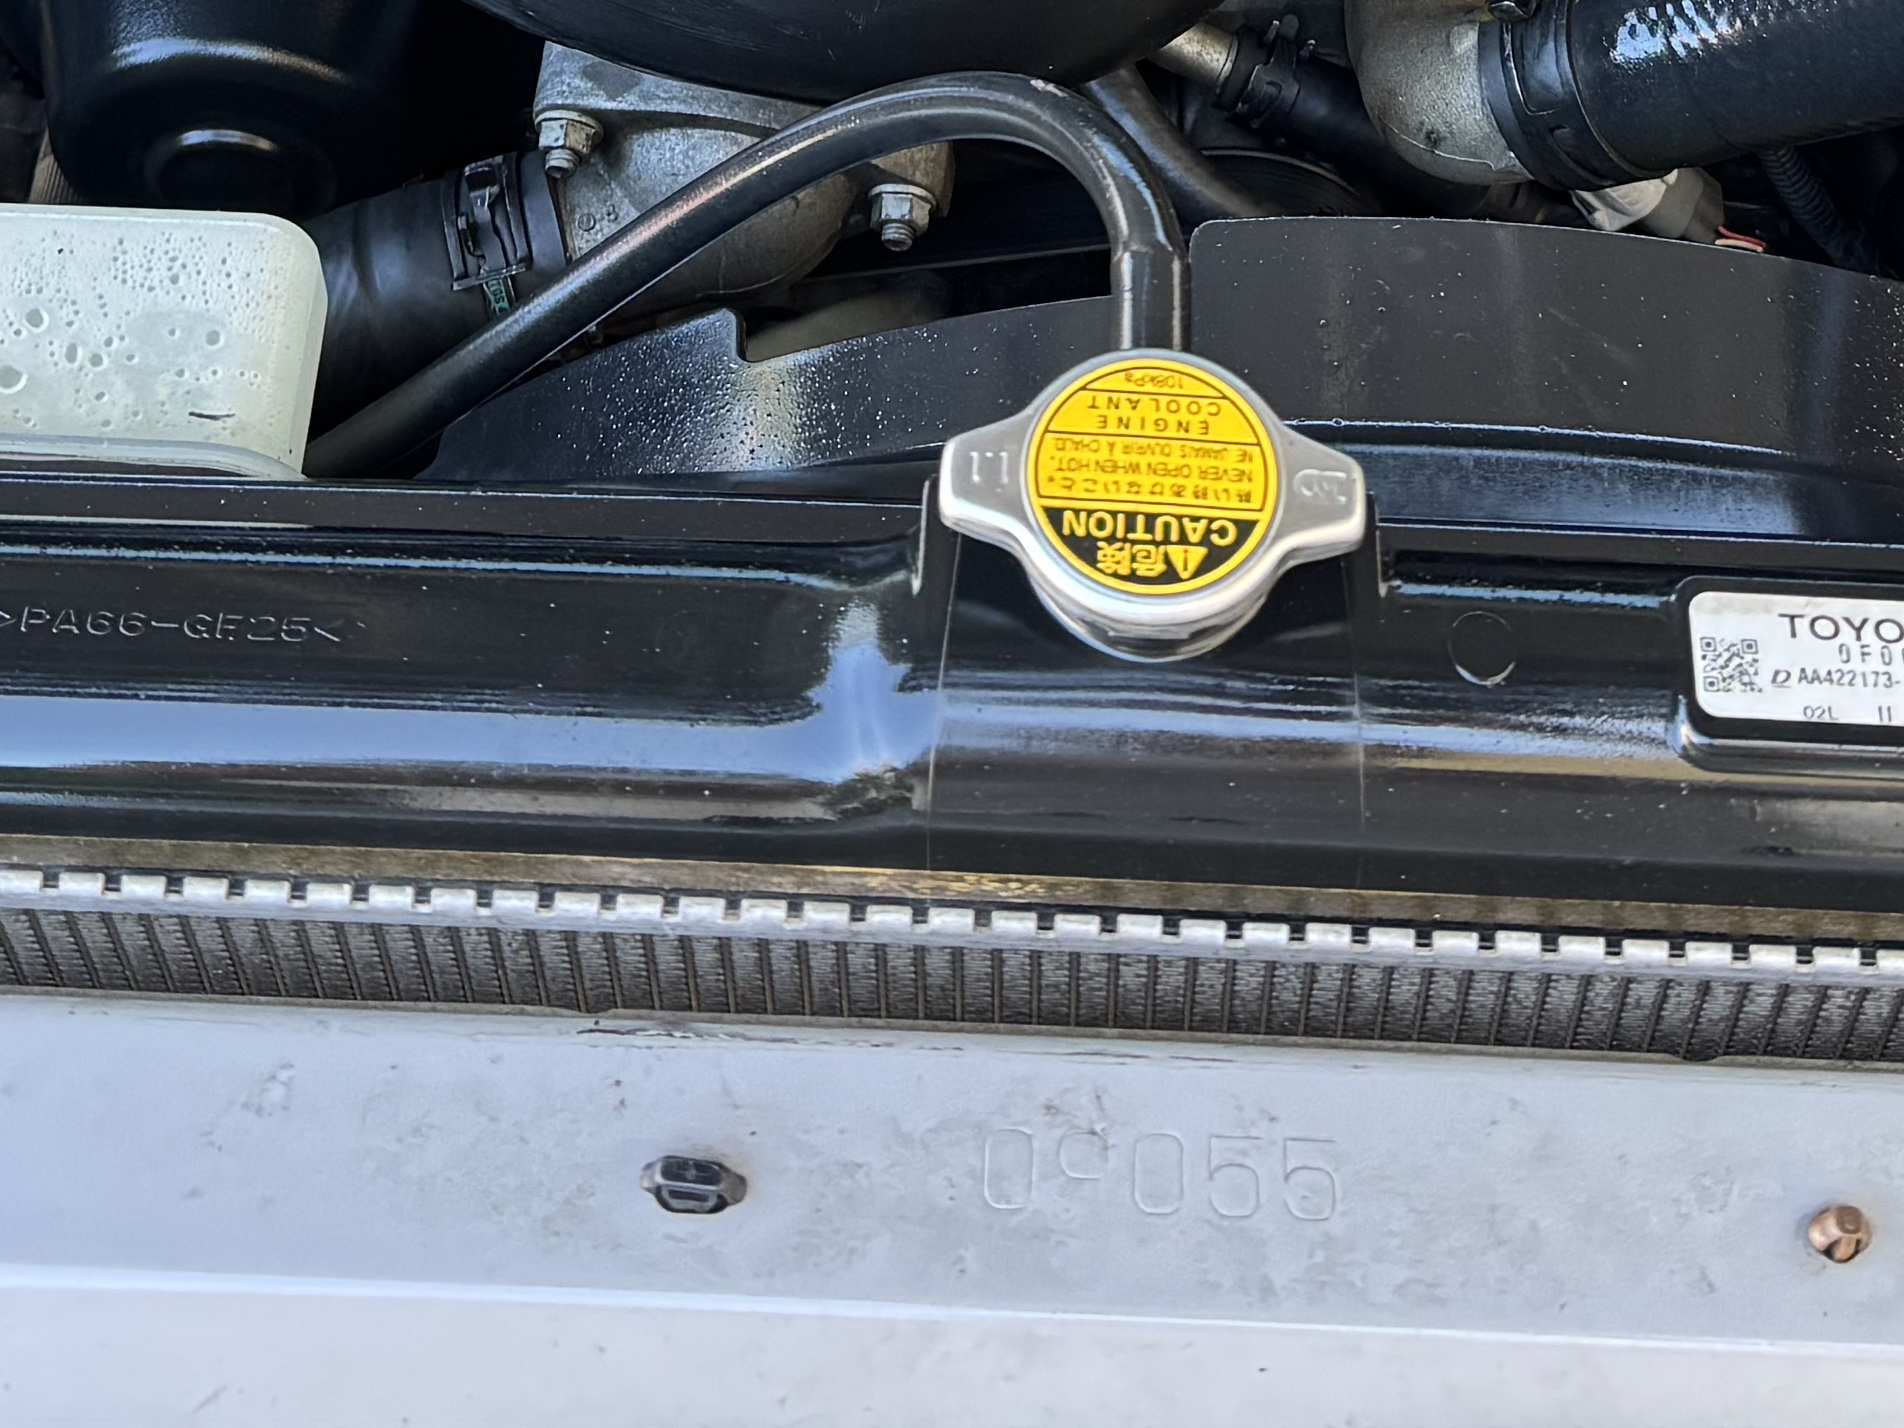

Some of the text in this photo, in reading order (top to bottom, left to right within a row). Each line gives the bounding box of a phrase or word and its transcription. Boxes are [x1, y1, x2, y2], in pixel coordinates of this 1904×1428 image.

[1087, 394, 1222, 417] COOLANT
[1096, 414, 1211, 436] ENGINE
[1094, 458, 1143, 475] WHEN
[1145, 461, 1192, 479] OPEN
[1197, 465, 1254, 483] NEVER
[1061, 510, 1238, 547] CAUTION
